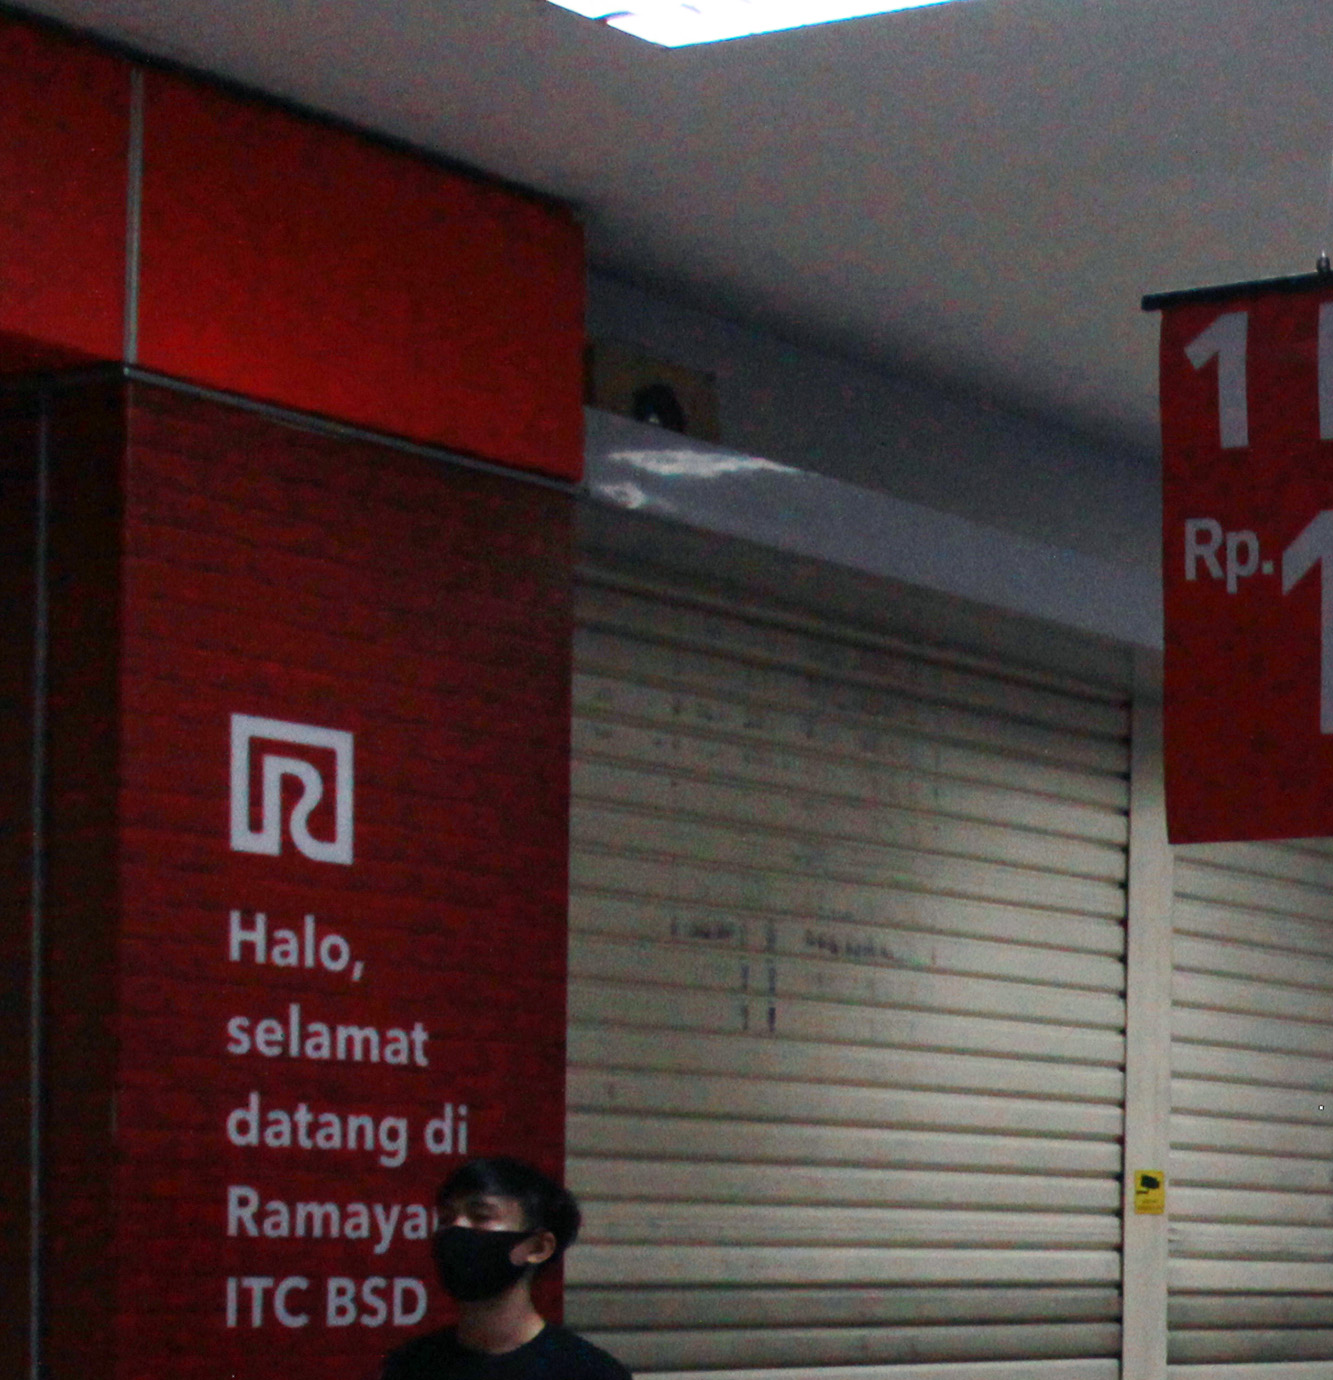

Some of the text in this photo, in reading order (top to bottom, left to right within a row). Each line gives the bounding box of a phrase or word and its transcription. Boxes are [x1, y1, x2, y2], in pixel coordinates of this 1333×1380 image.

[1184, 311, 1249, 449] 1
[229, 909, 364, 981] Halo,
[227, 1003, 429, 1067] selamat
[226, 1091, 468, 1168] datang di
[226, 1275, 428, 1329] ITC BSD
